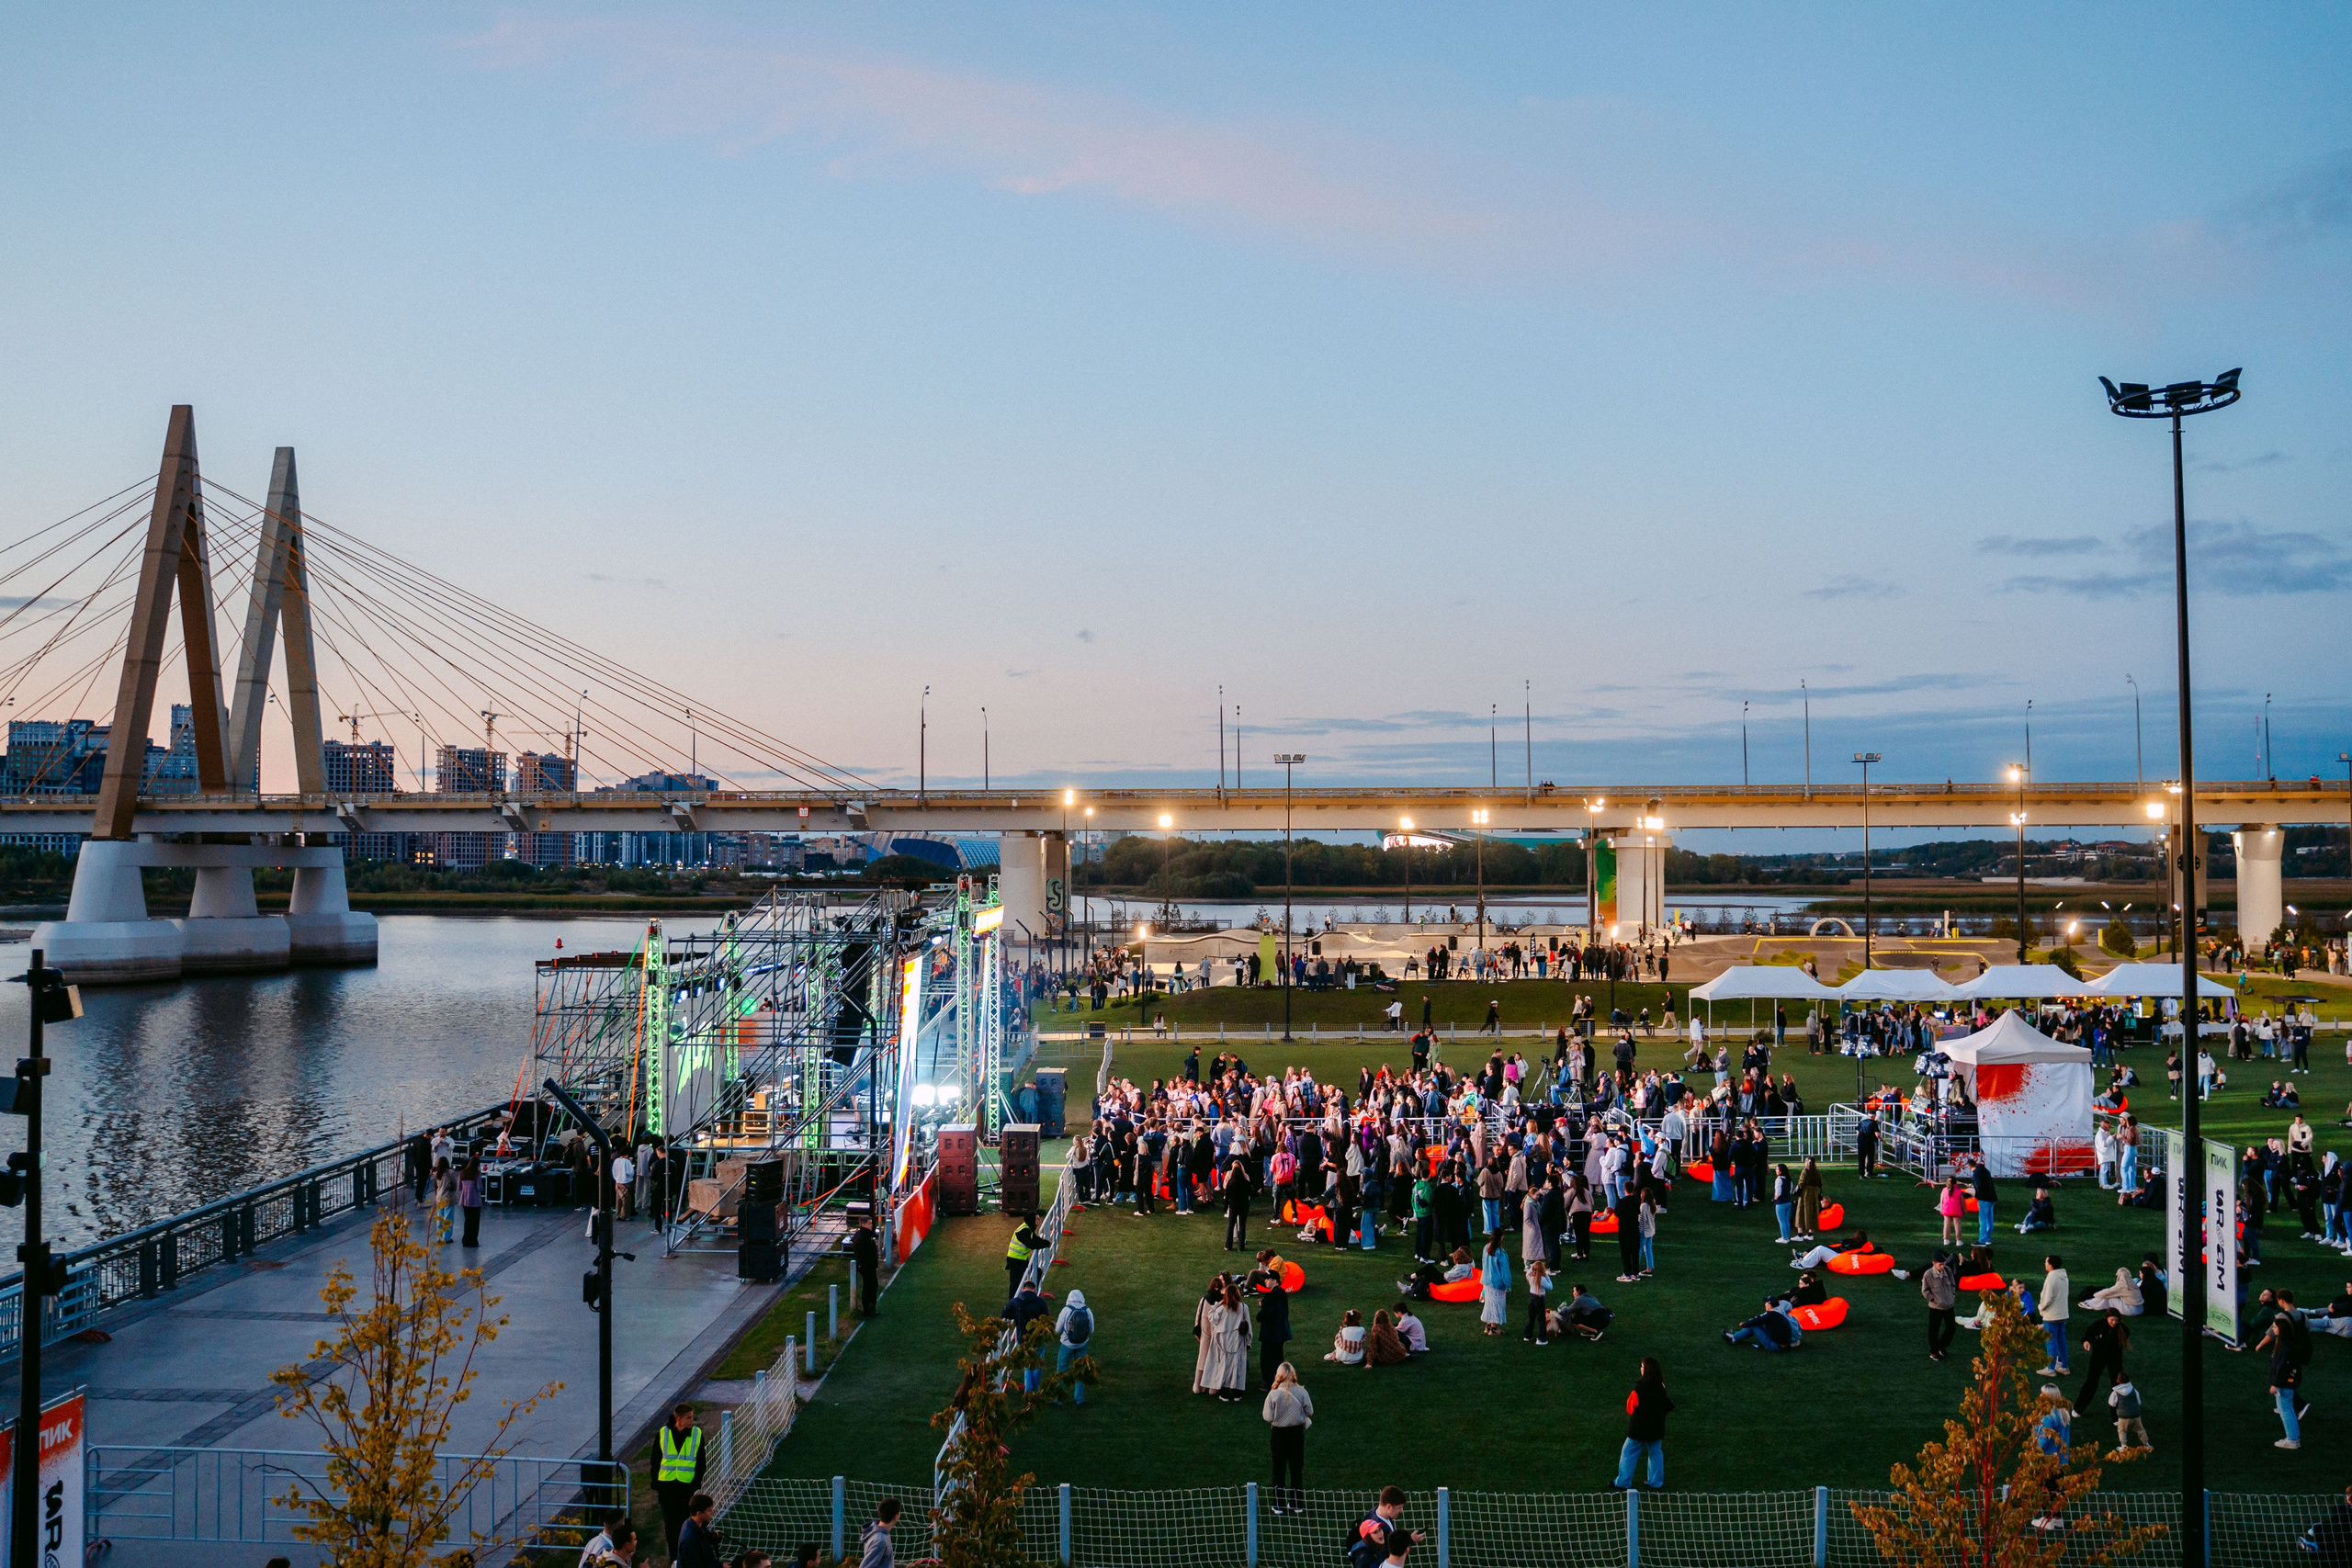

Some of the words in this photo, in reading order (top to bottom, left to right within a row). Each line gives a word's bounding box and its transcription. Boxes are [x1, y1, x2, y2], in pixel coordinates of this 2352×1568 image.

[2173, 1142, 2184, 1156] ПИ
[2211, 1153, 2228, 1170] ПИК
[1850, 1253, 1860, 1270] ПИК
[1804, 1308, 1822, 1325] ПИК
[39, 1418, 73, 1452] ПИК
